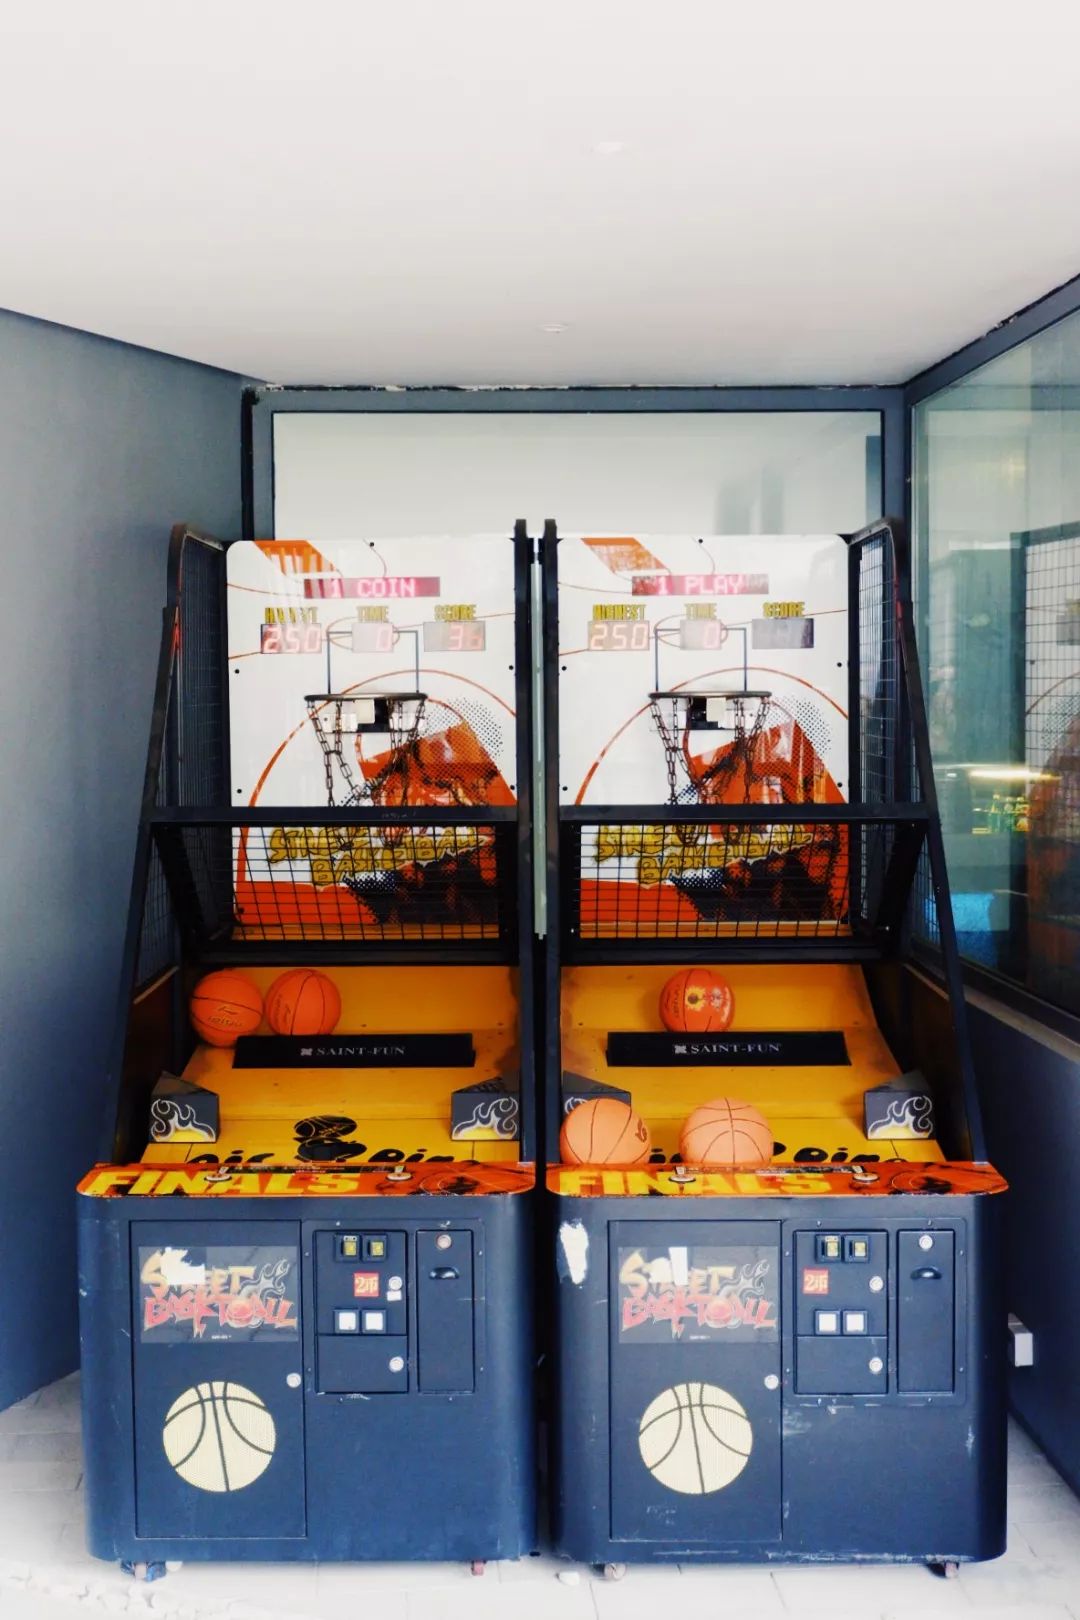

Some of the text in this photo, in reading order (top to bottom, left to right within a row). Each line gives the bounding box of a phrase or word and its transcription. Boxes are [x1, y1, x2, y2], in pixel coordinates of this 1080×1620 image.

[356, 579, 416, 597] COIN
[657, 575, 744, 594] 1 PLAY
[763, 602, 805, 618] SCORE
[263, 625, 321, 653] 250
[590, 623, 649, 649] 250
[704, 622, 722, 648] 0
[316, 1045, 406, 1057] SAINT-FUN
[690, 1043, 780, 1054] SAINT-FUN
[88, 1170, 361, 1195] FINALS
[559, 1170, 832, 1196] FINALS
